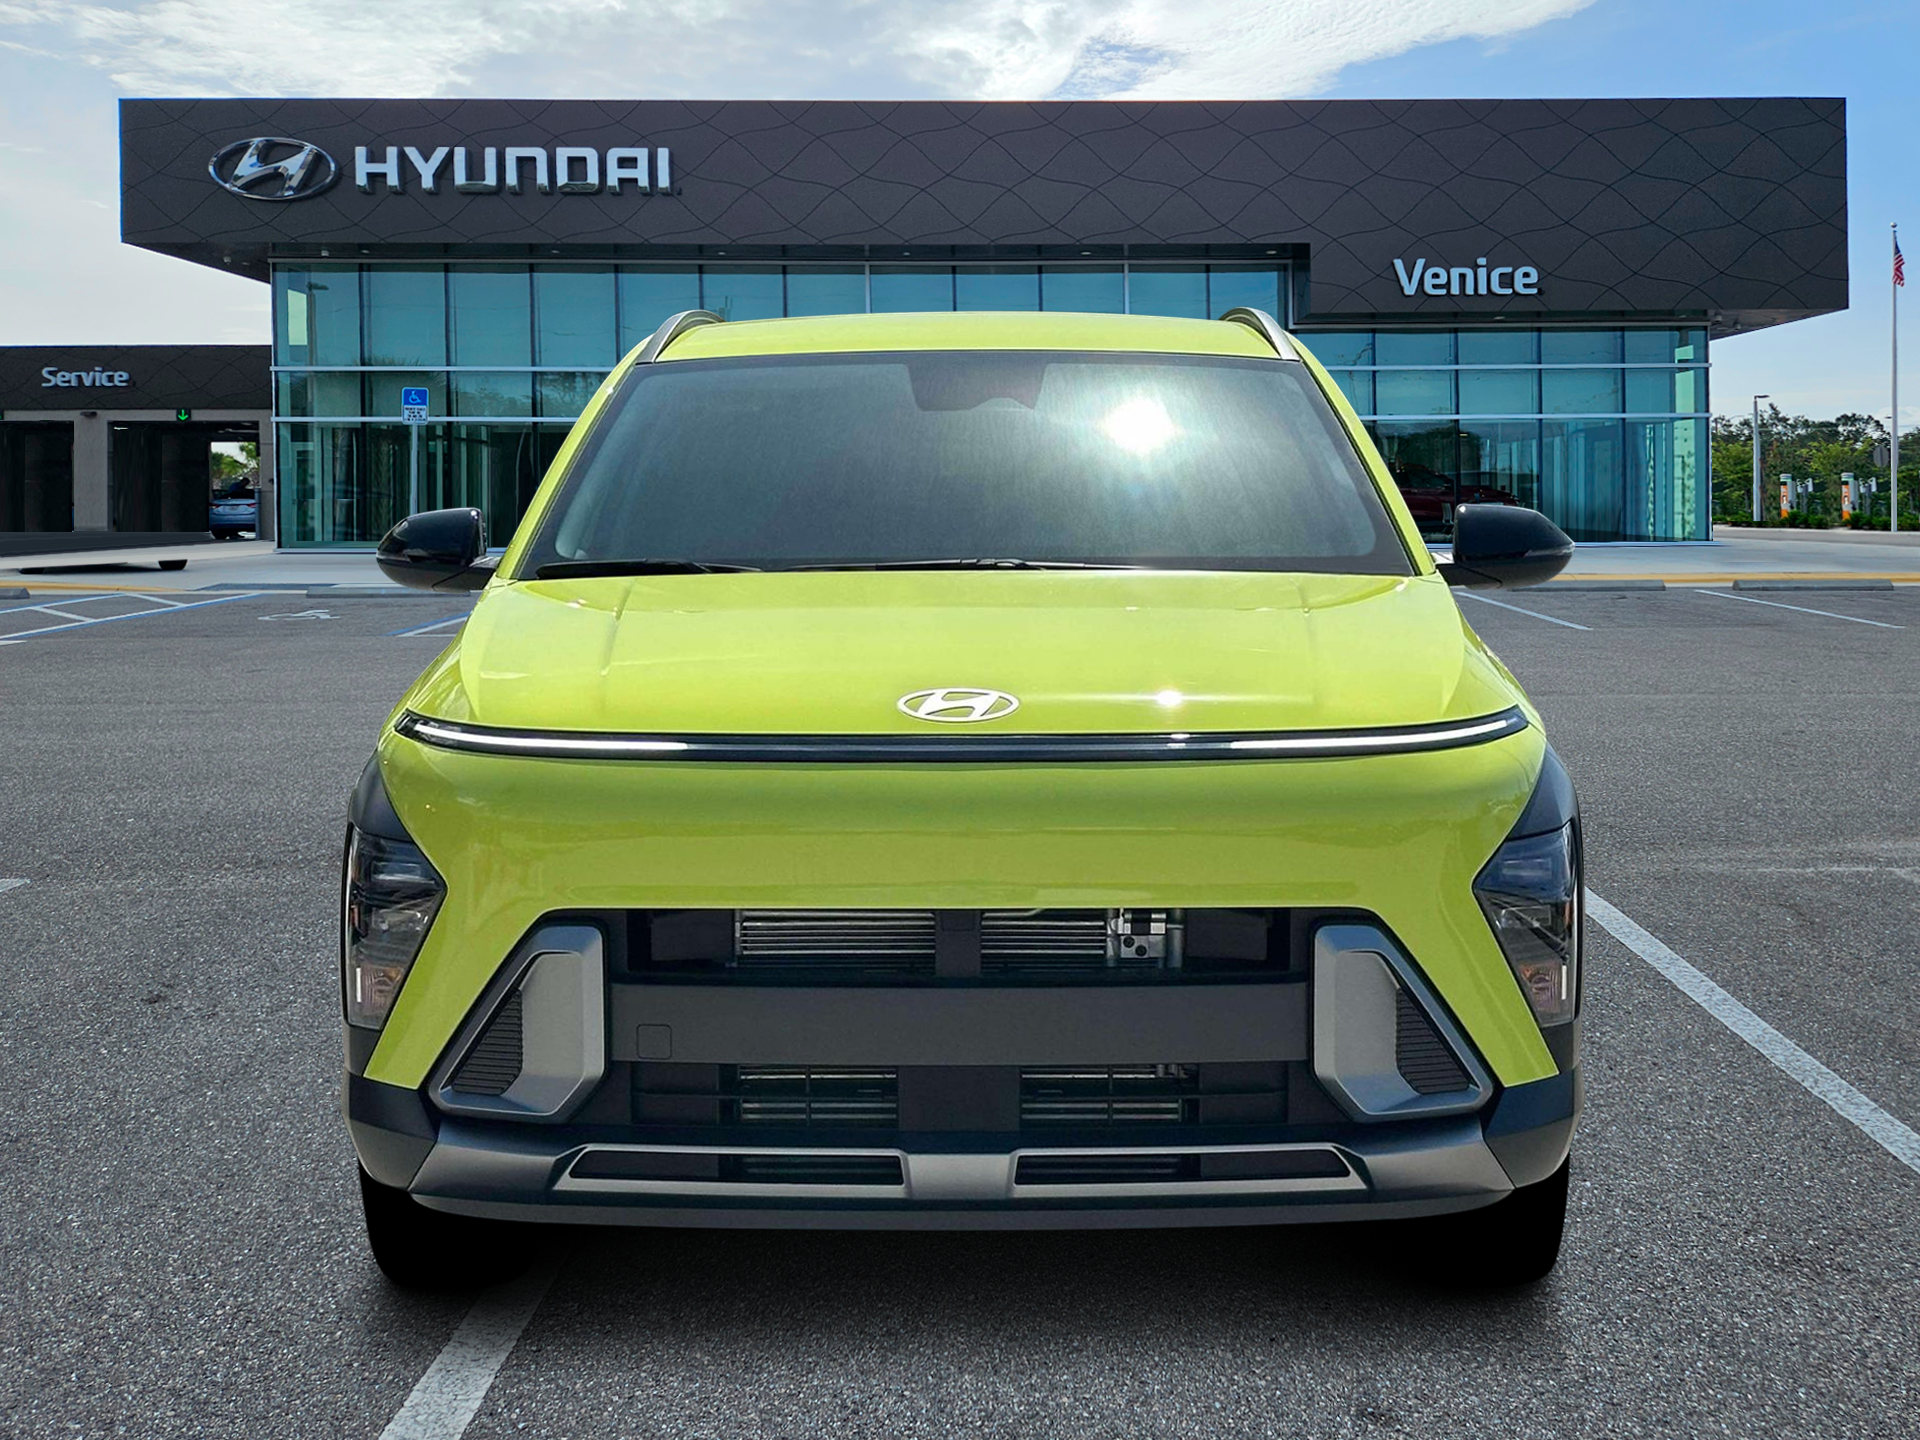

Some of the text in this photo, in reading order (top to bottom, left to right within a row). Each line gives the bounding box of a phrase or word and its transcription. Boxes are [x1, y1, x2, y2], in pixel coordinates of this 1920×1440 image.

[355, 146, 671, 192] HYUNDAI
[1393, 257, 1538, 295] Venice
[41, 366, 130, 387] Service
